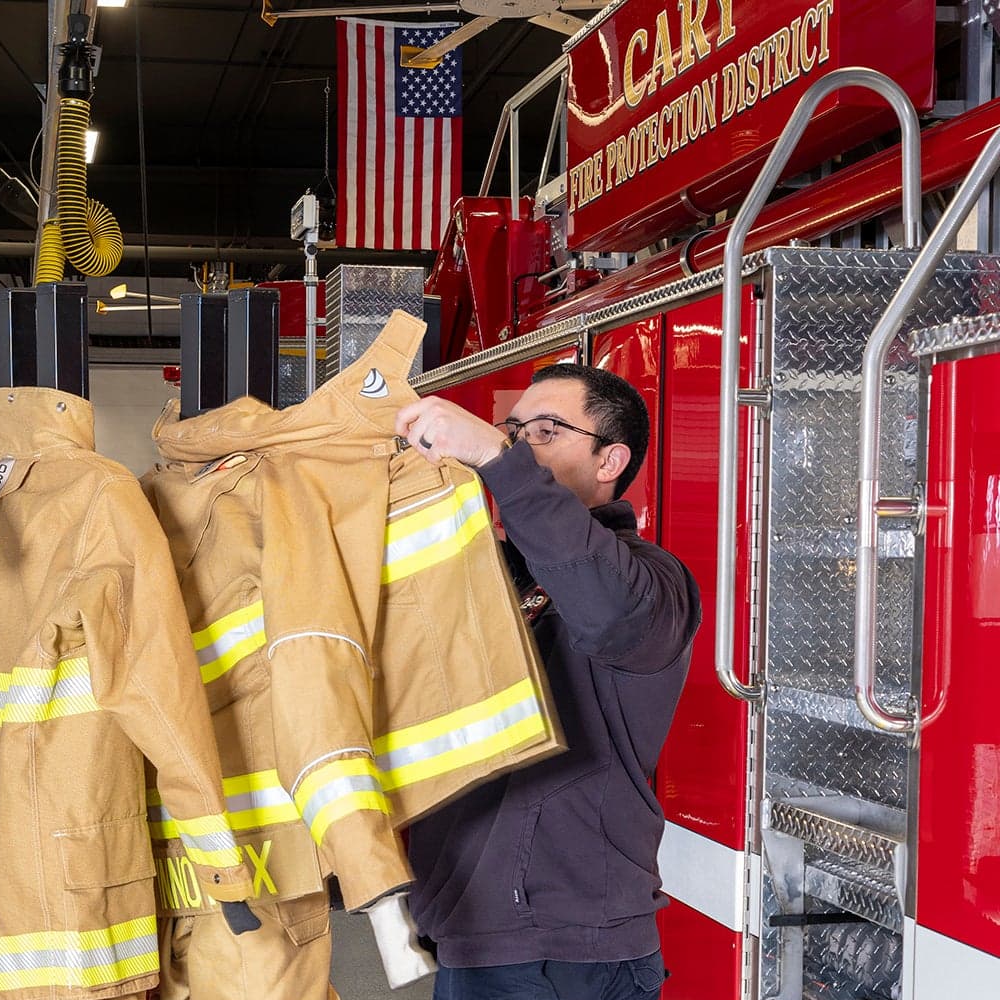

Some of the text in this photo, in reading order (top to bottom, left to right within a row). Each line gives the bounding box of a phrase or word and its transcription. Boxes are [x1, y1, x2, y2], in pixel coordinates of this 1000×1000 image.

[569, 0, 833, 214] FIRE PROTECTION DISTRICT
